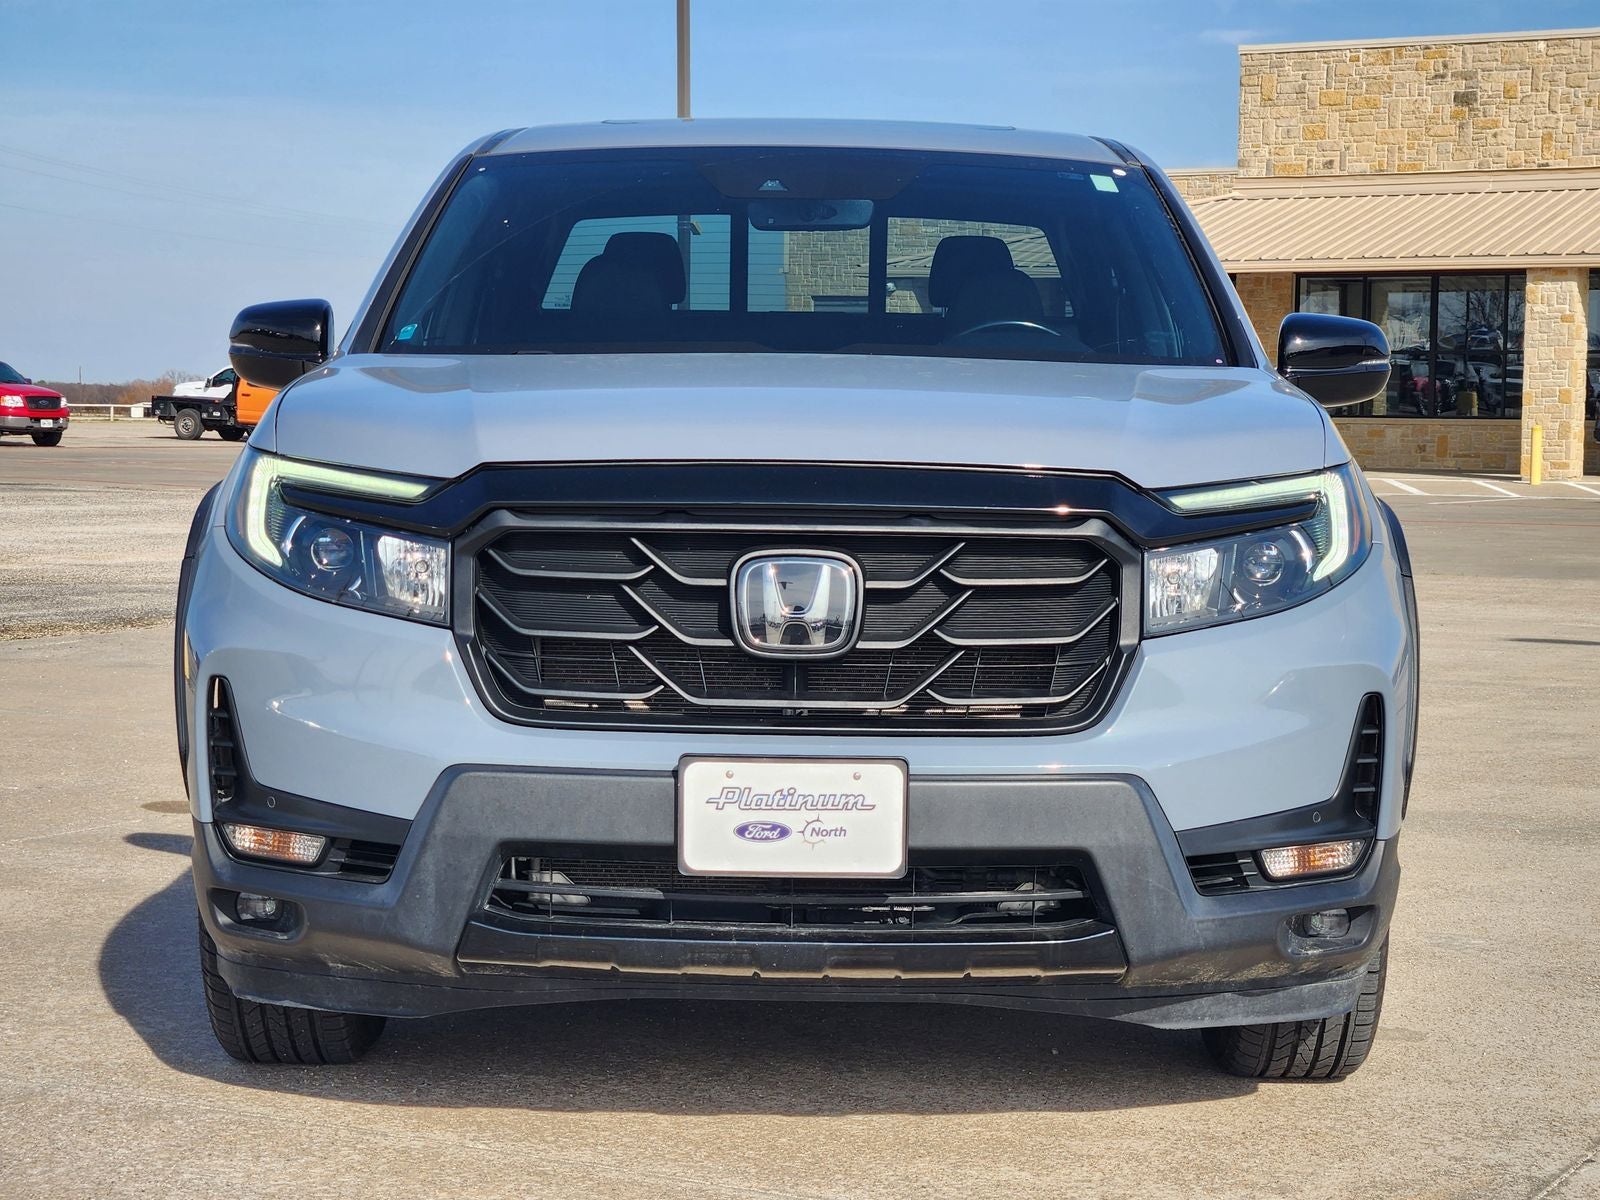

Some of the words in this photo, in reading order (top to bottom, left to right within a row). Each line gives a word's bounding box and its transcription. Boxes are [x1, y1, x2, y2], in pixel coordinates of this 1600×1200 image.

[705, 786, 877, 811] Platinum
[744, 824, 781, 841] Ford
[810, 826, 847, 838] North
